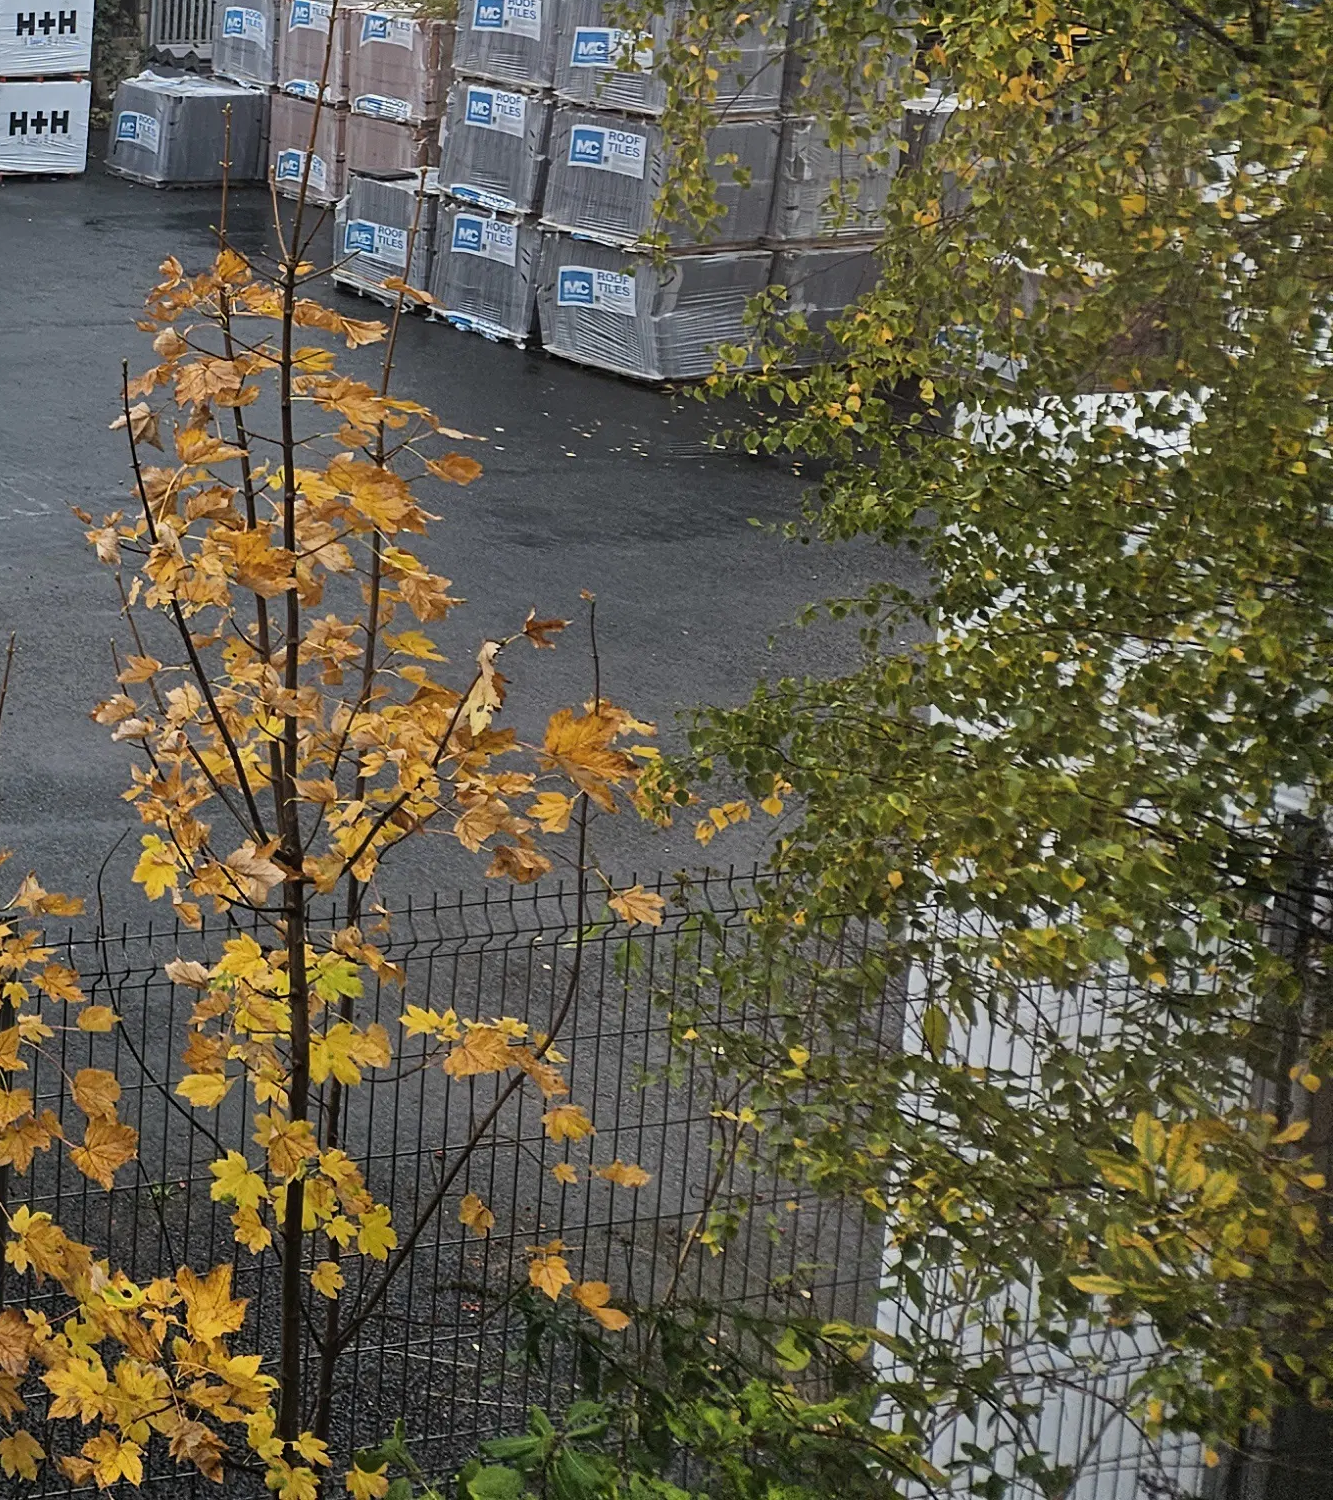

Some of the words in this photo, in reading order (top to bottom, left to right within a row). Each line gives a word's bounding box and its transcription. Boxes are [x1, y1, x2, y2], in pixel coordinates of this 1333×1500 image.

[295, 7, 309, 18] MC
[479, 5, 501, 20] MC
[507, 6, 537, 20] TILES
[16, 10, 77, 36] H+H
[226, 17, 242, 28] MC
[578, 42, 607, 55] MC
[496, 92, 521, 105] ROOF
[470, 100, 490, 115] MC
[495, 103, 521, 118] TILES
[9, 110, 70, 136] H+H
[608, 131, 642, 145] ROOF
[576, 139, 601, 155] MC
[608, 141, 641, 158] TILES
[377, 225, 404, 238] ROOF
[458, 228, 480, 243] MC
[485, 220, 513, 236] ROOF
[377, 235, 404, 250] TILES
[485, 231, 513, 247] TILES
[596, 271, 631, 285] ROOF
[563, 280, 591, 296] MC
[596, 282, 631, 298] TILES
